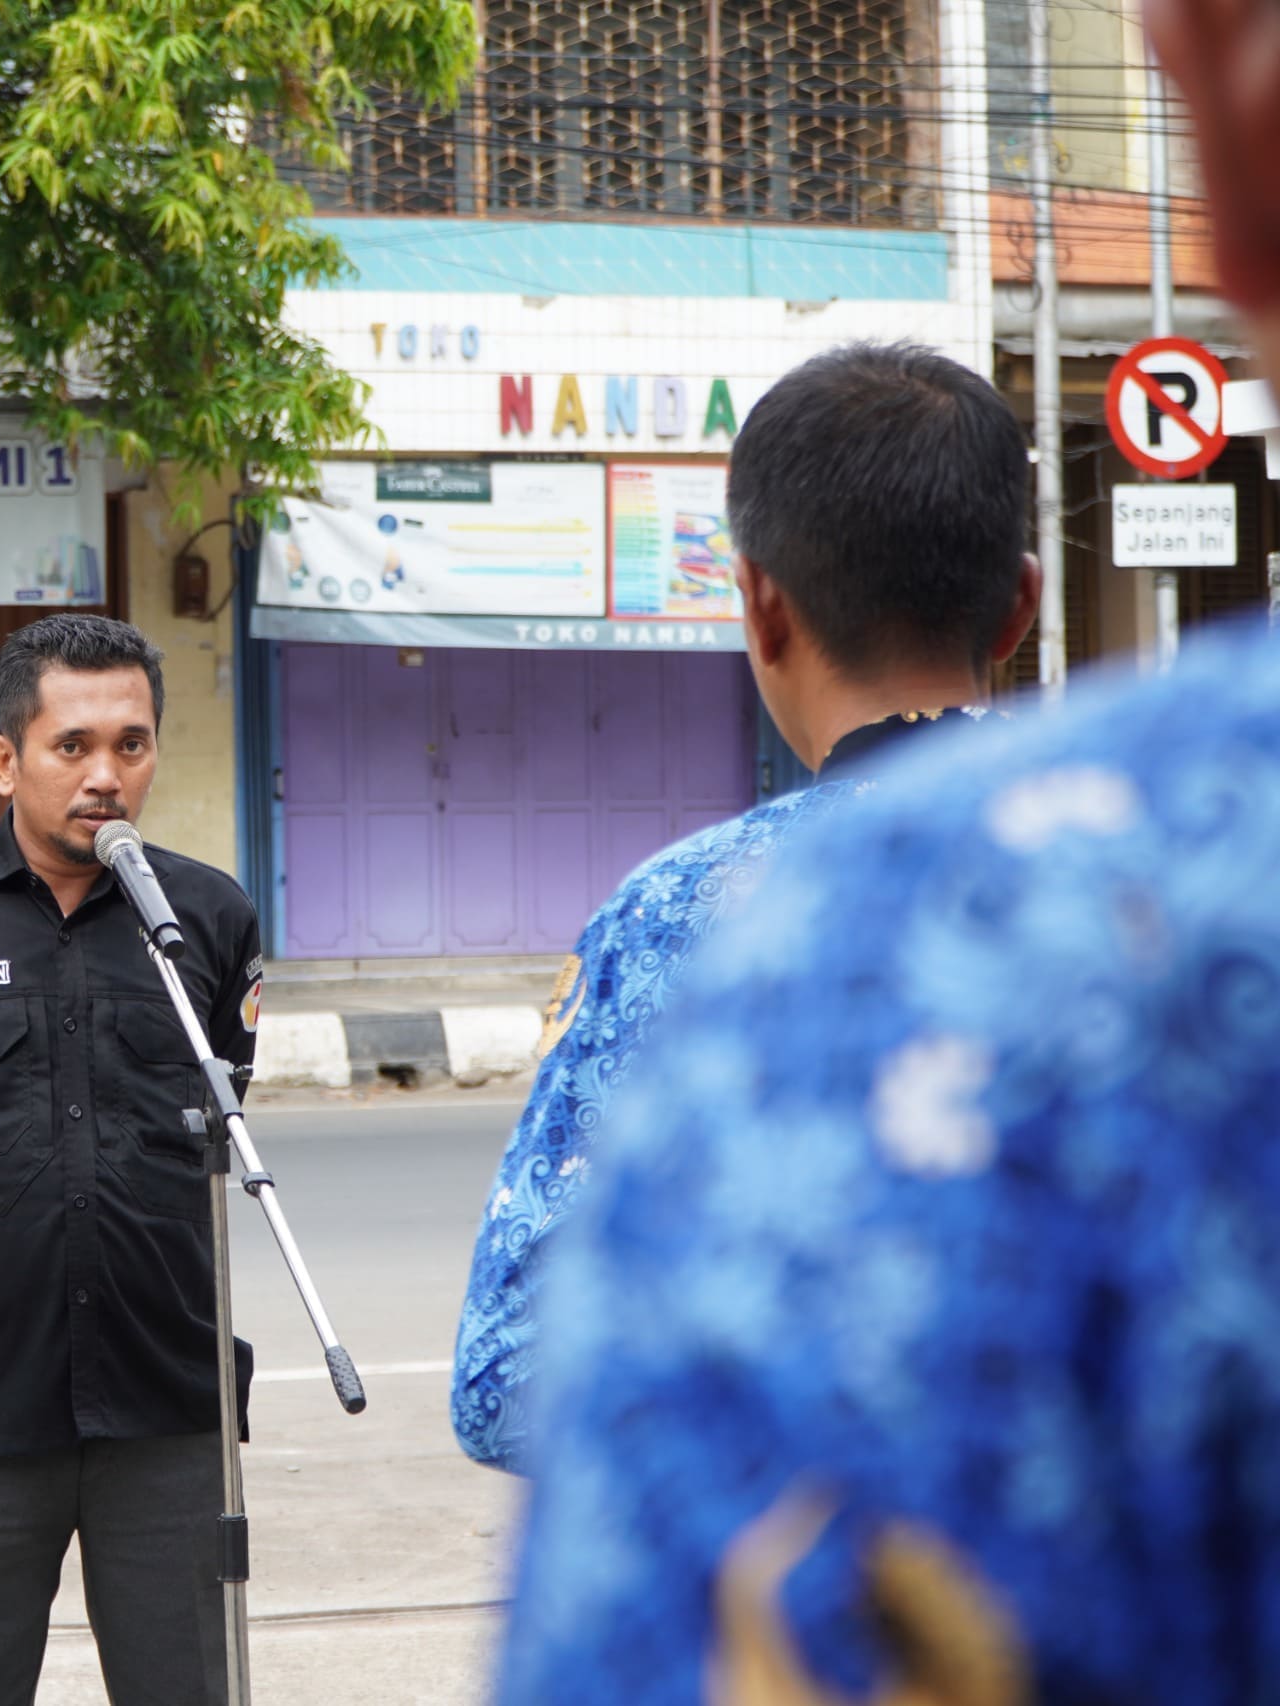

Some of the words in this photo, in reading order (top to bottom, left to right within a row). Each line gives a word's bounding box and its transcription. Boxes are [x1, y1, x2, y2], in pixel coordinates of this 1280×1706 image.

[371, 323, 480, 360] TOKO
[499, 373, 738, 437] NANDA
[46, 446, 73, 486] 1
[1116, 503, 1233, 527] Sepanjang
[1127, 532, 1188, 552] Jalan
[1199, 532, 1224, 550] Ini
[516, 624, 598, 643] TOKO
[614, 624, 717, 644] NANDA
